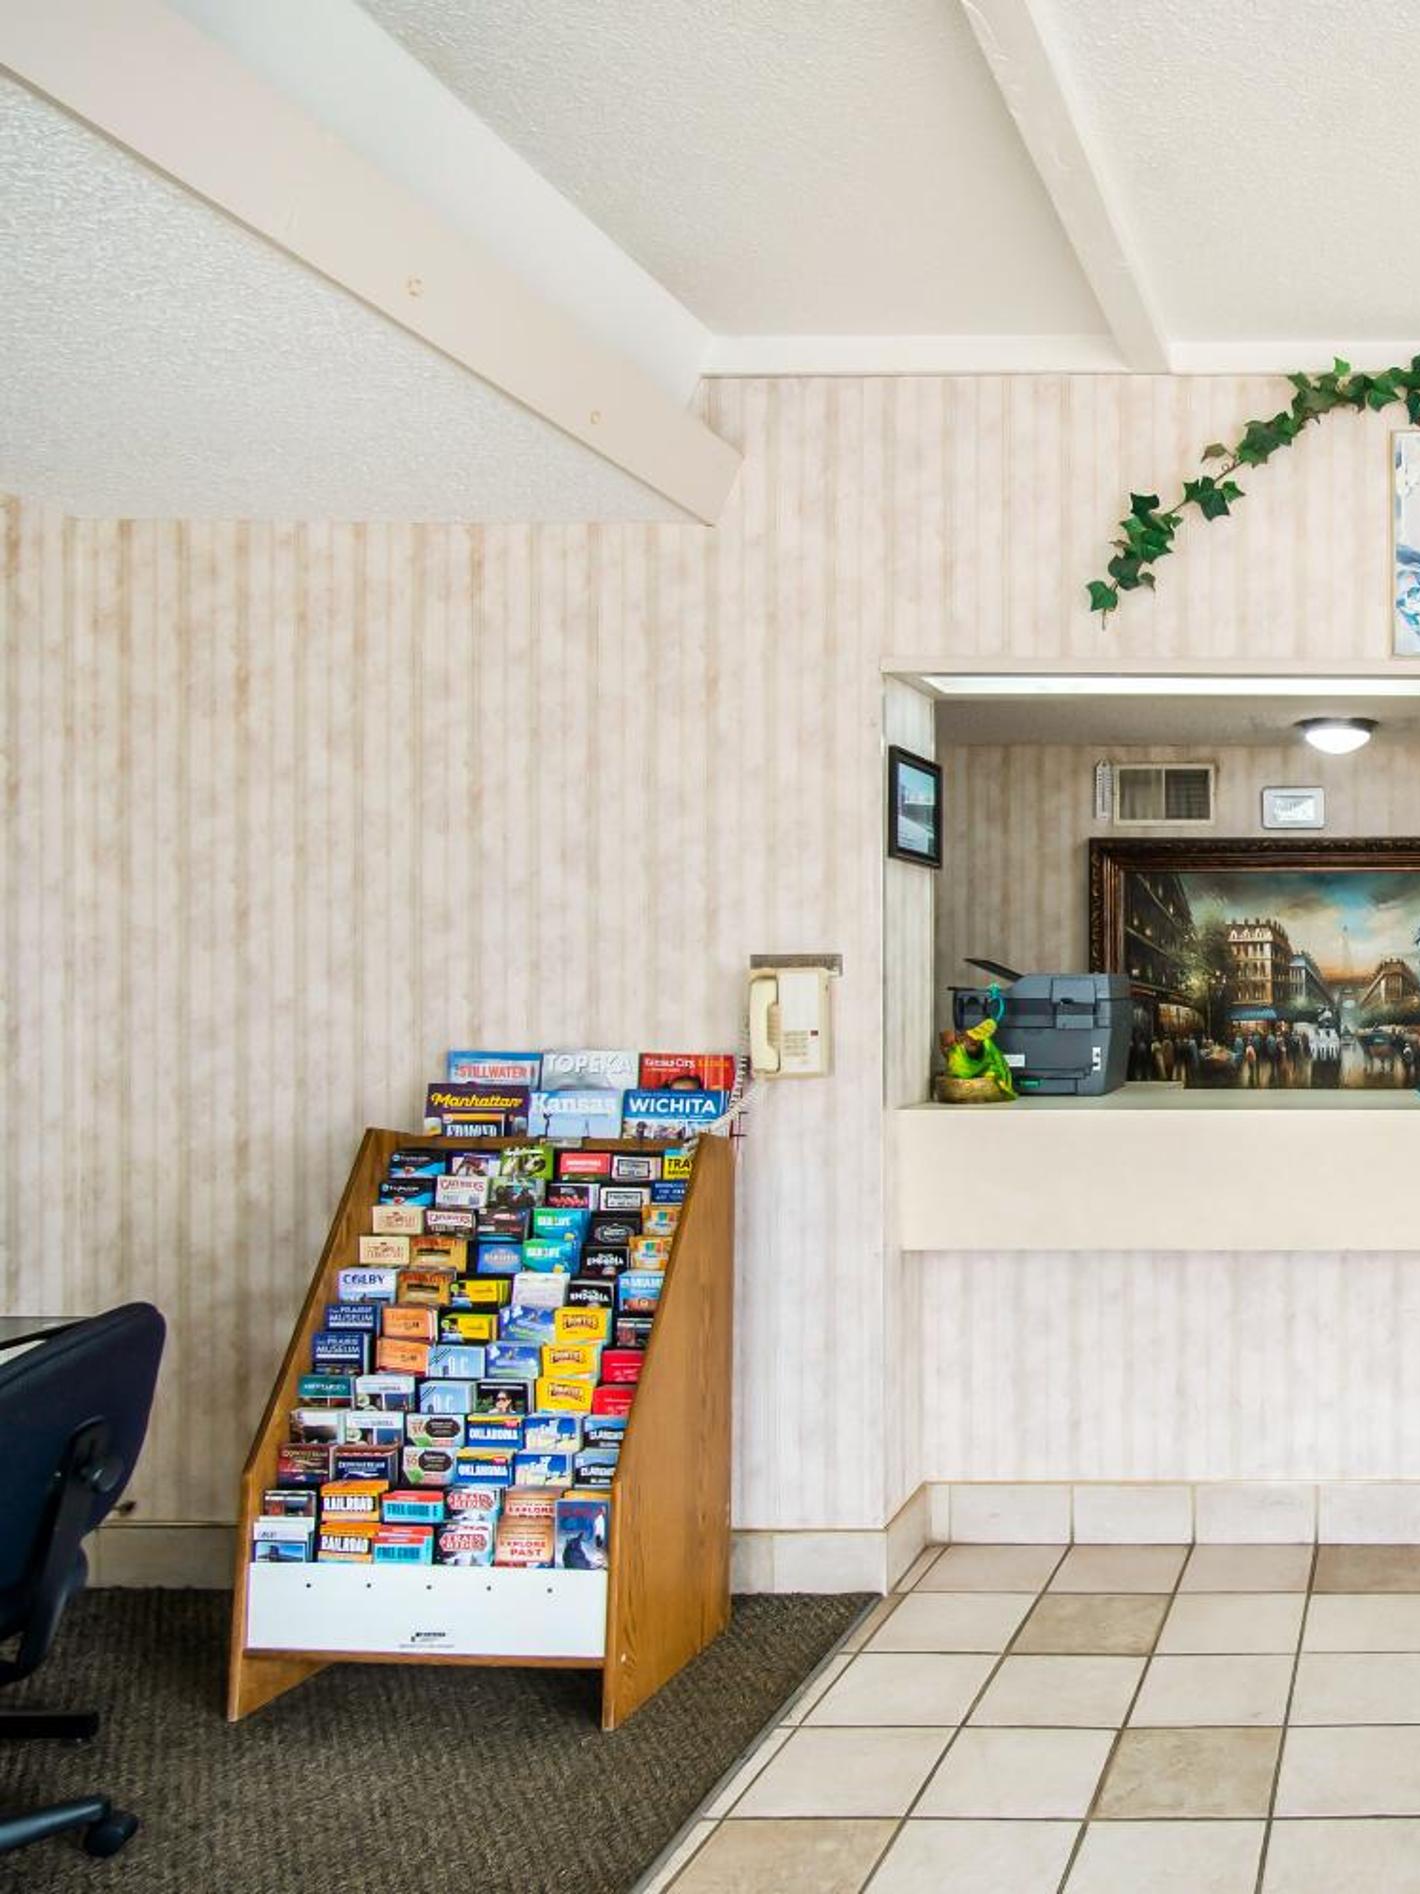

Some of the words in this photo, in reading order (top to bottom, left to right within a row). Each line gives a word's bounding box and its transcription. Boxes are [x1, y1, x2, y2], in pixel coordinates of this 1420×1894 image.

[456, 1064, 528, 1078] STILLWATER
[548, 1054, 631, 1074] TOPEKA
[431, 1091, 524, 1108] Manhattan
[530, 1092, 616, 1116] Kansas
[629, 1097, 718, 1115] WICHITA
[342, 1274, 385, 1285] COLBY
[316, 1345, 361, 1353] MUSEUM
[469, 1428, 518, 1440] OKLAHOMA
[458, 1465, 508, 1476] OKLAHOMA
[324, 1496, 374, 1511] RAILROAD
[386, 1503, 405, 1516] FREE
[406, 1503, 429, 1516] GUIDE
[322, 1535, 369, 1553] RAILROAD
[376, 1547, 395, 1560] FREE
[396, 1547, 420, 1560] GUIDE
